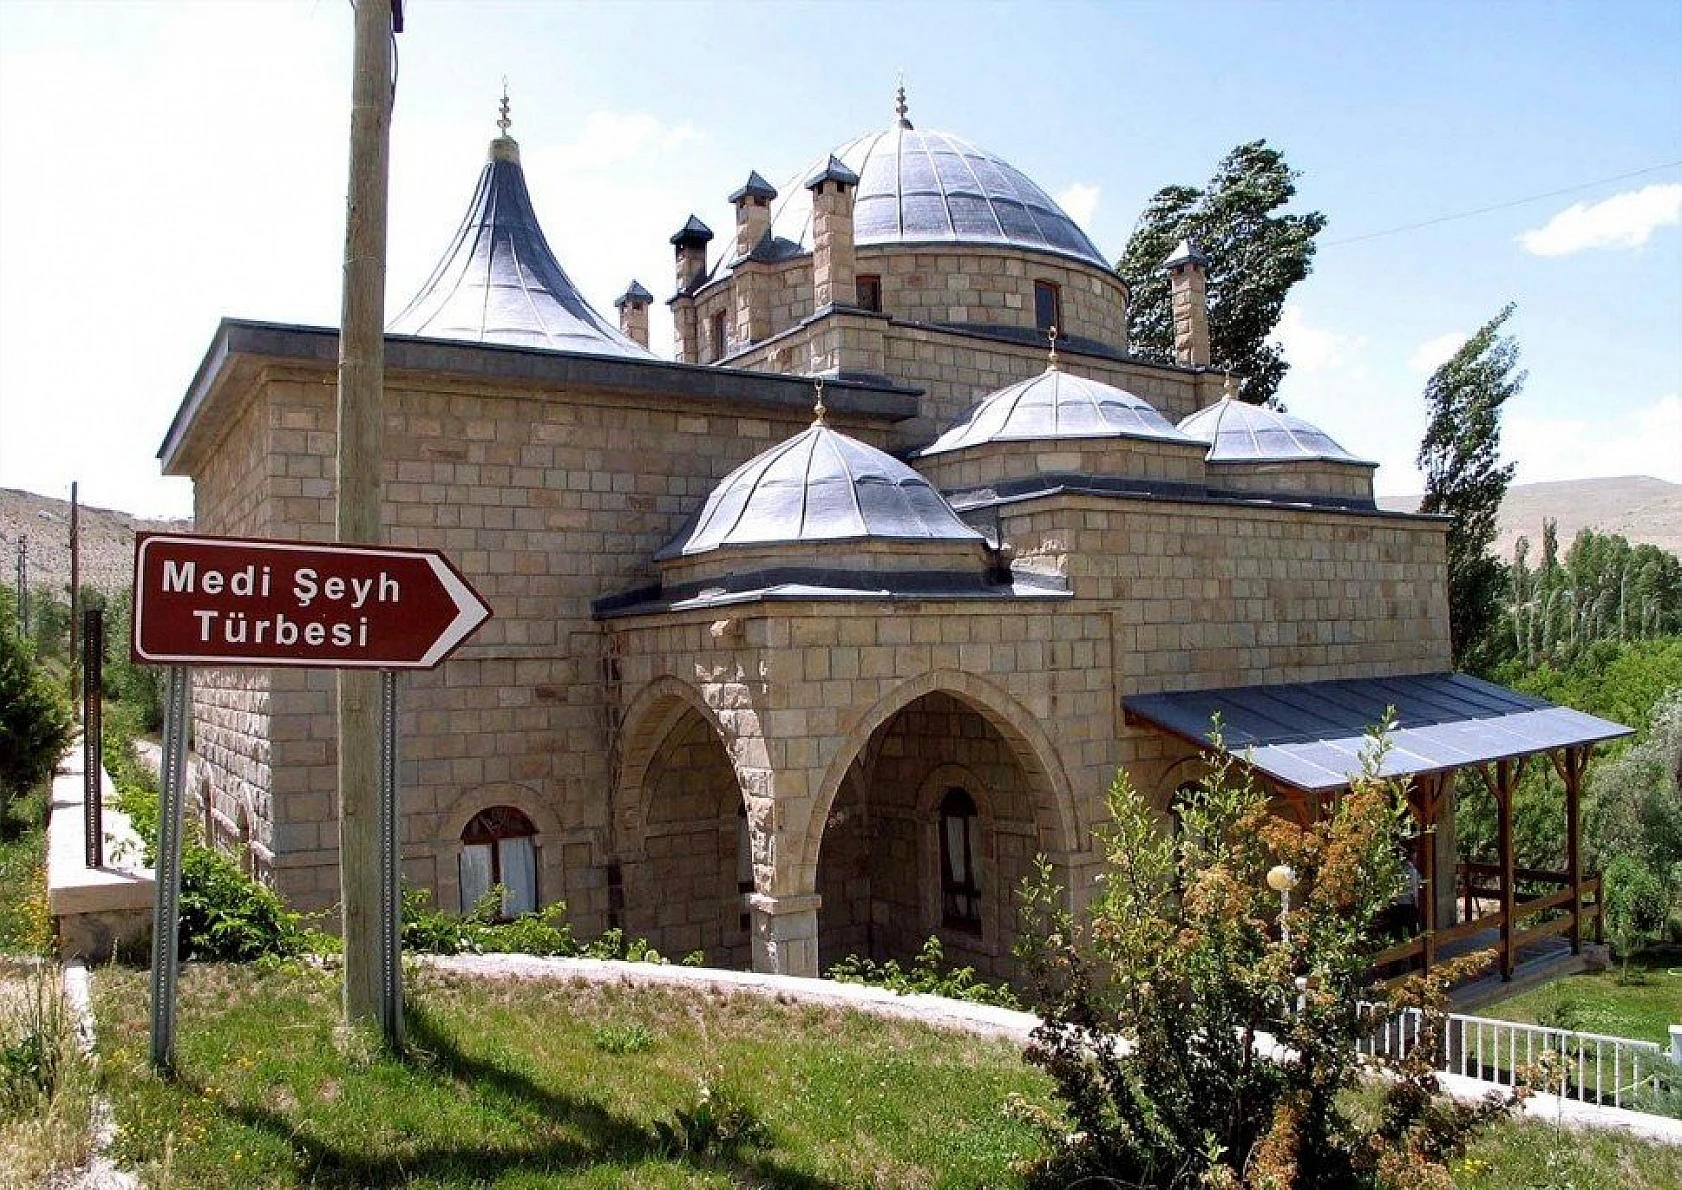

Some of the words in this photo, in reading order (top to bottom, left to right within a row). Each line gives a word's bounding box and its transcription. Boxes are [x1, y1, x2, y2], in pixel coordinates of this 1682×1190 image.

[161, 560, 272, 597] Medi
[293, 568, 400, 608] Şeyh
[192, 610, 368, 647] Türbesi
